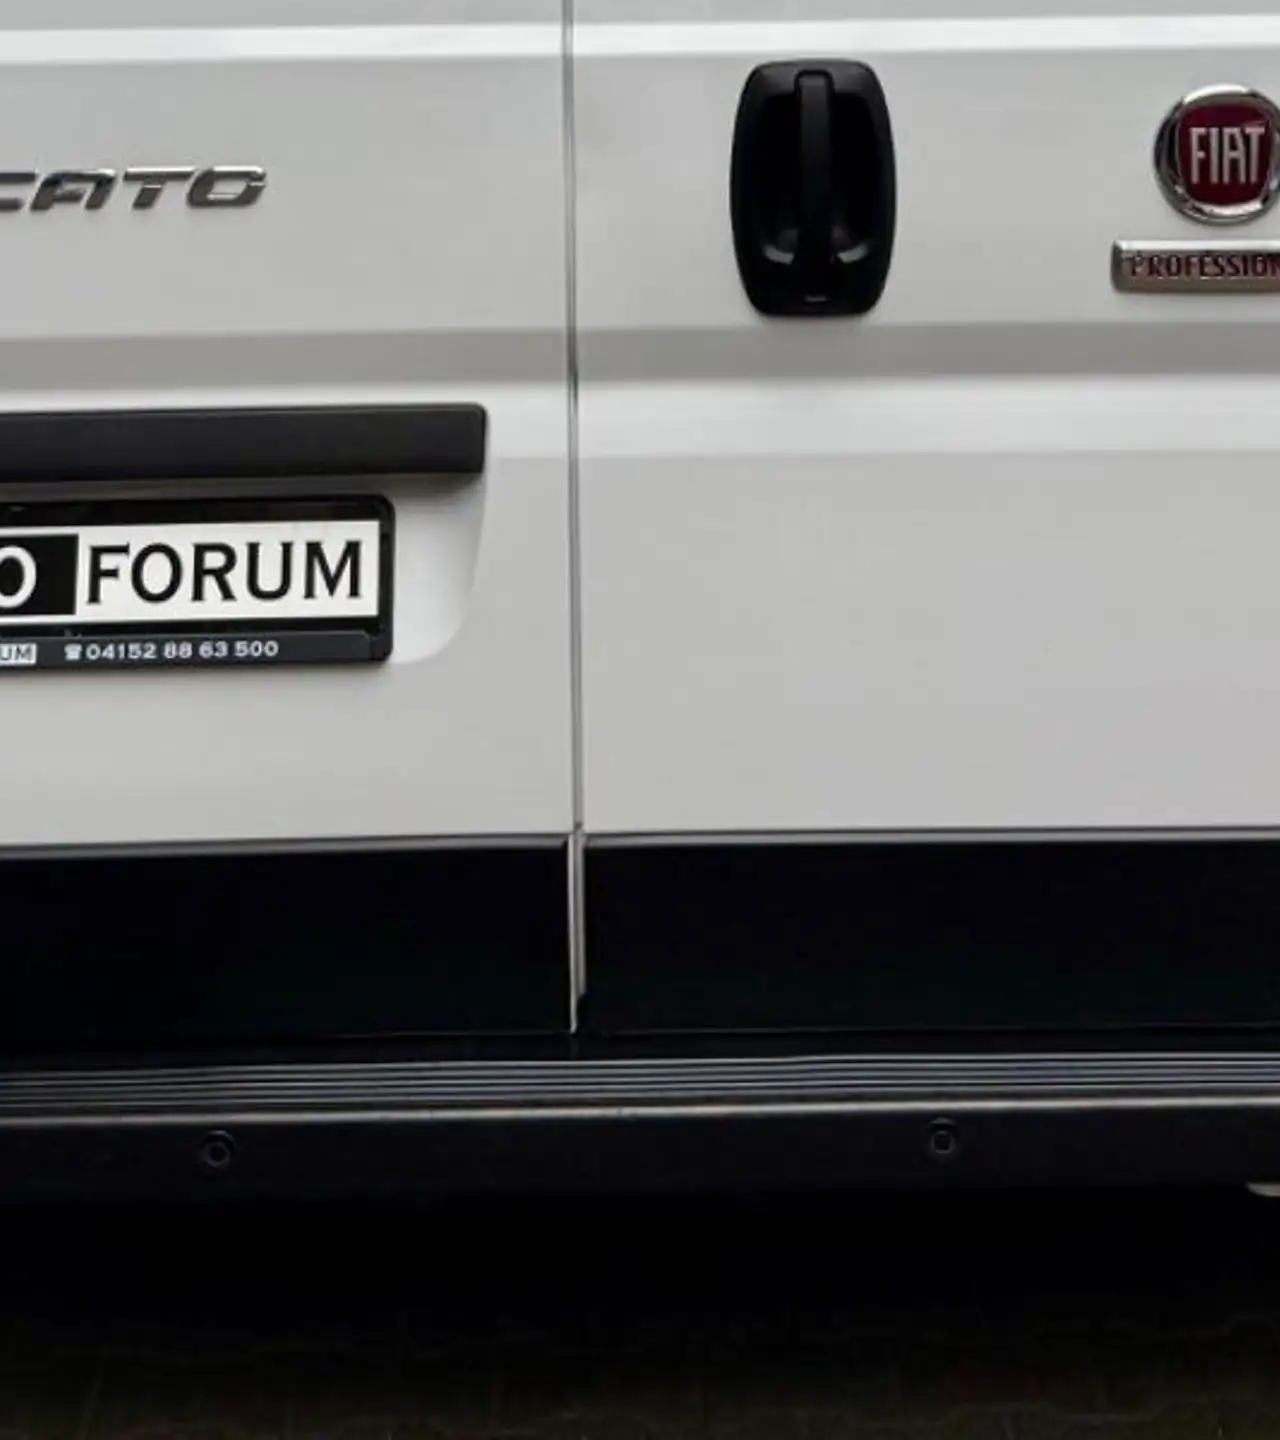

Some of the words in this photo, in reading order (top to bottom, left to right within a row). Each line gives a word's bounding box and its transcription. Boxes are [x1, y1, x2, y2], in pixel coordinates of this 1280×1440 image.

[1188, 126, 1266, 185] FIAT
[86, 539, 363, 605] FORUM
[85, 643, 157, 661] 04152
[163, 642, 193, 659] 88
[198, 641, 228, 659] 63
[233, 640, 280, 658] 500
